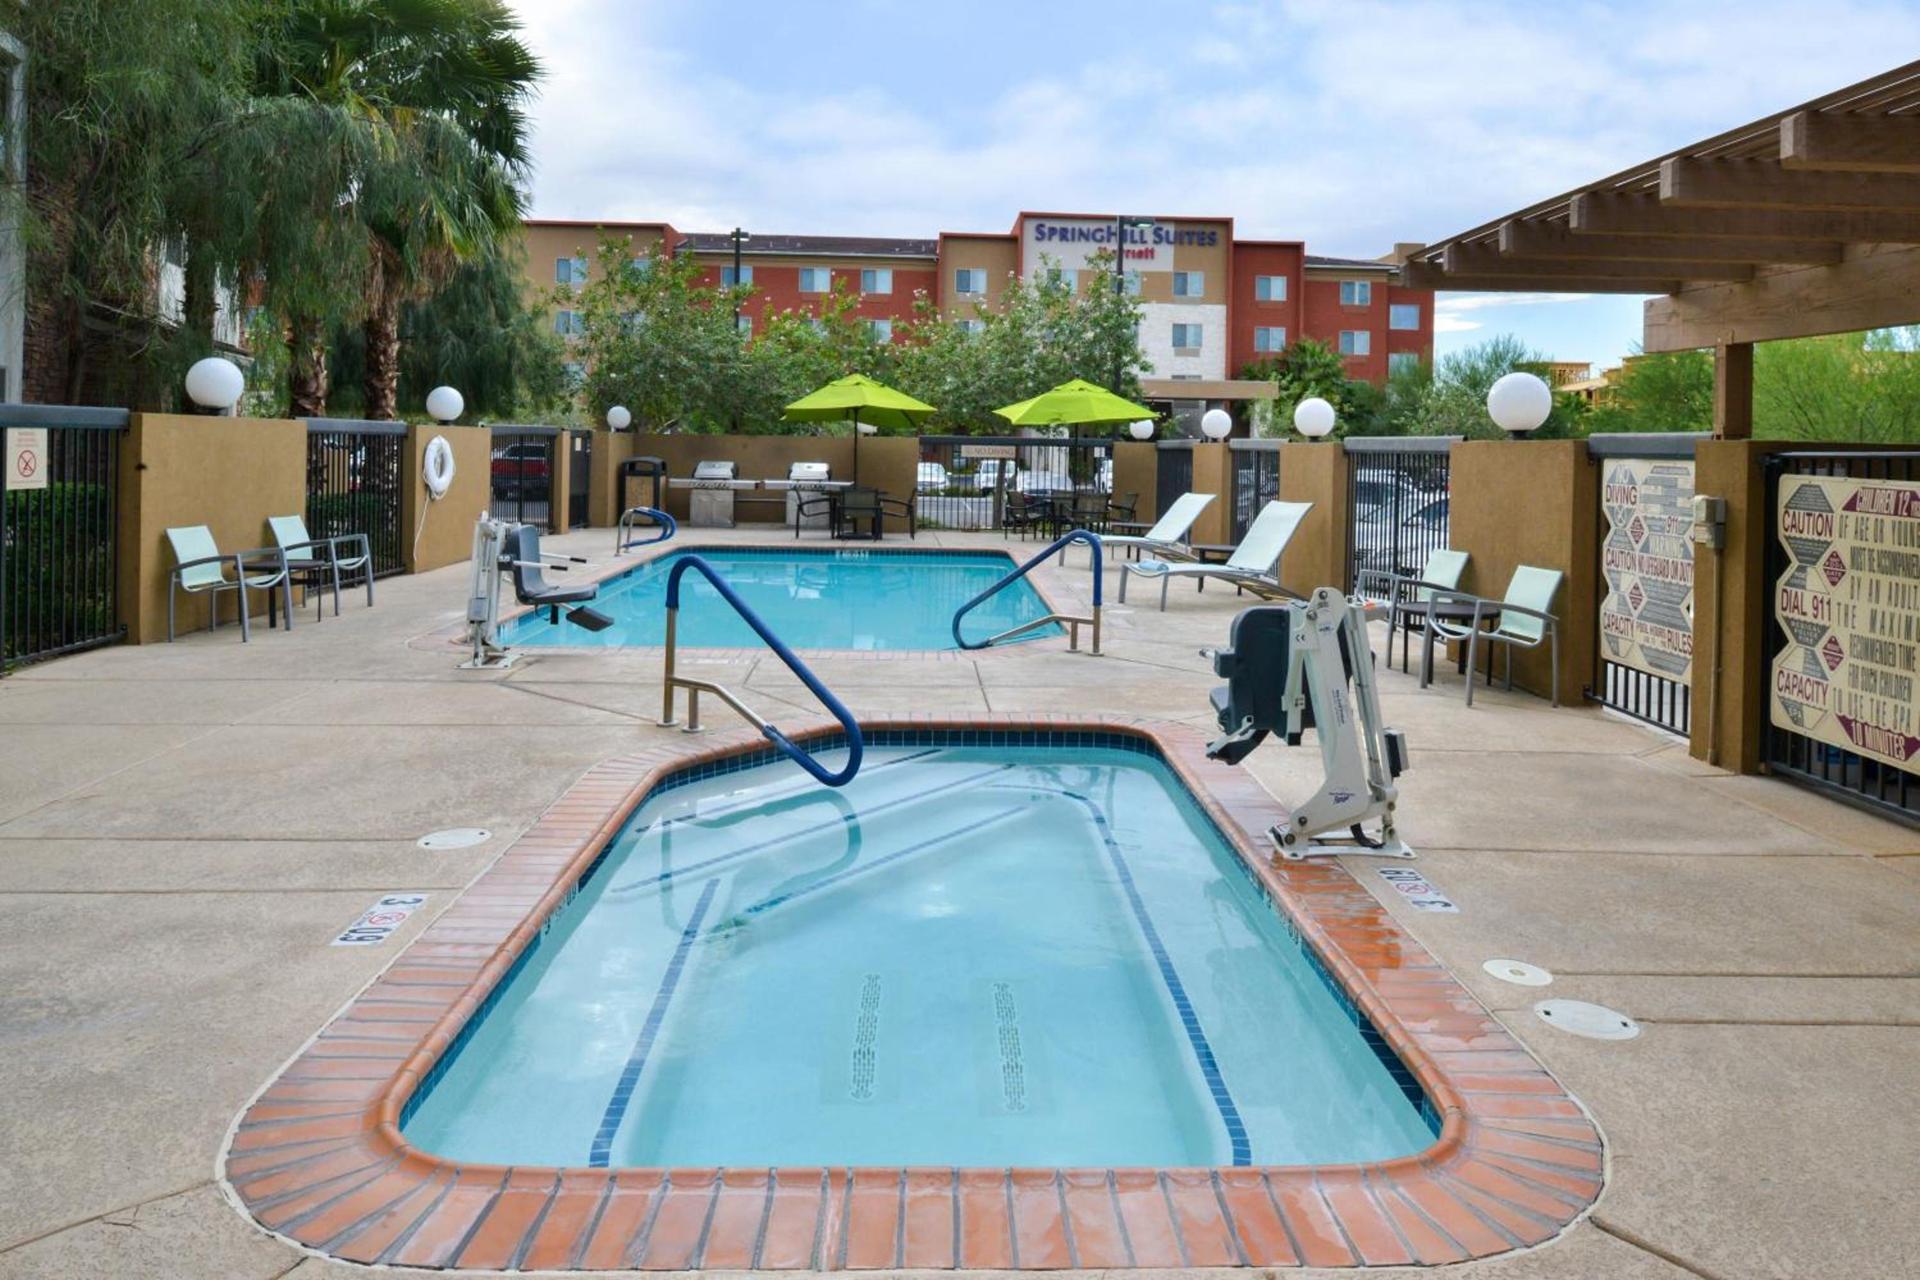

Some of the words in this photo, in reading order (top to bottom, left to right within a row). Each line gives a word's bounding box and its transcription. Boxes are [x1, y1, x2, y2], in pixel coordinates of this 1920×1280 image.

[1606, 484, 1638, 506] DIVING
[1855, 487, 1897, 516] CHILDREN
[1897, 490, 1911, 516] 12
[1666, 515, 1678, 535] 911
[1782, 510, 1834, 538] CAUTION
[1839, 514, 1849, 540] OF
[1854, 515, 1869, 542] AGE
[1873, 517, 1885, 544] OR
[1606, 547, 1636, 573] CAUTION
[1850, 545, 1866, 572] MUST
[1867, 547, 1876, 574] BE
[1850, 574, 1862, 603] BY
[1867, 577, 1880, 605] AN
[1781, 588, 1808, 616] DIAL
[1811, 595, 1832, 622] 911
[1836, 601, 1857, 630] THE
[1603, 610, 1634, 640] CAPACITY
[1667, 629, 1693, 656] RULES
[1898, 643, 1916, 673] TIME
[1776, 669, 1830, 706] CAPACITY
[1879, 669, 1912, 704] CHILDREN
[1833, 687, 1843, 713] TO
[1848, 689, 1863, 720] USE
[1869, 697, 1887, 727] THE
[1893, 703, 1911, 735] SPA
[1851, 720, 1863, 747] 10
[1864, 724, 1905, 761] MINUTES
